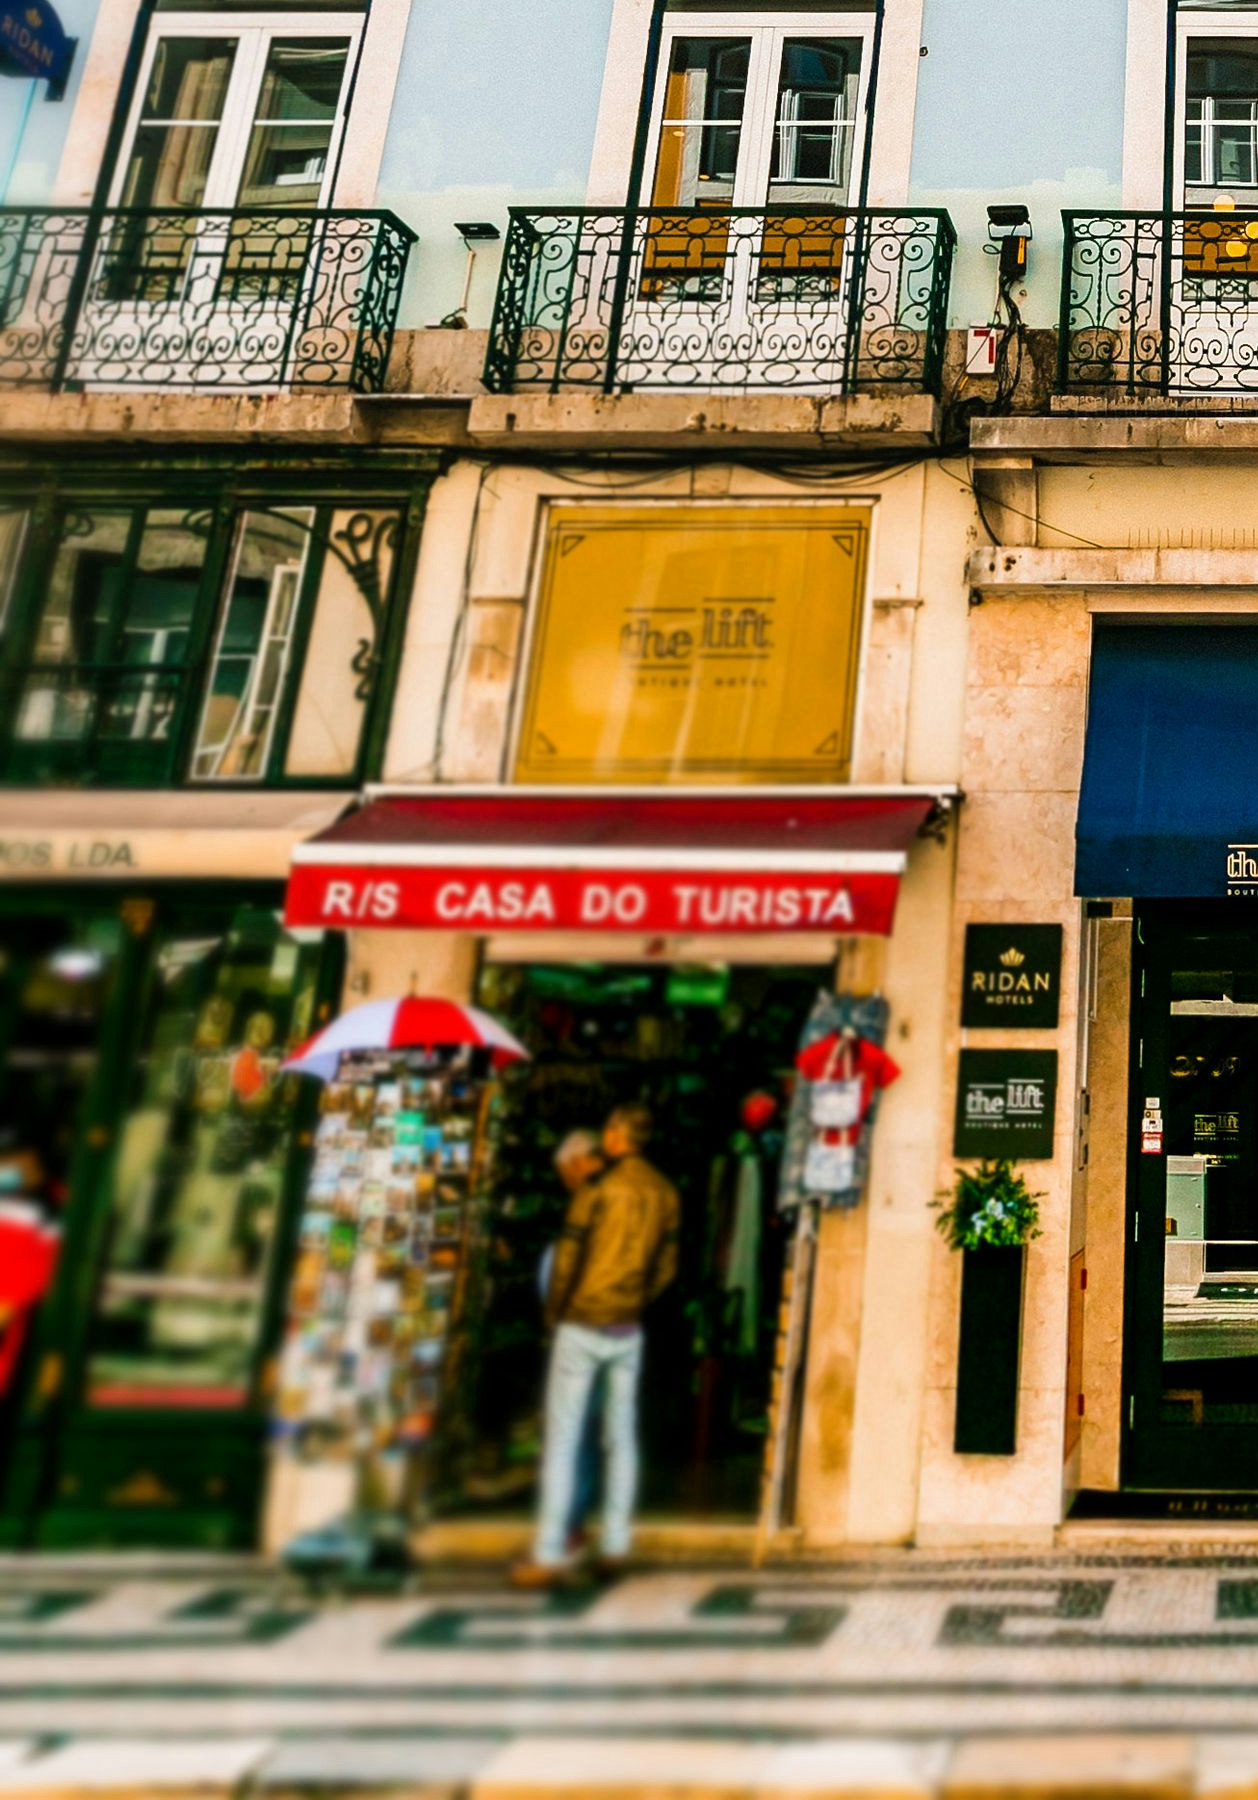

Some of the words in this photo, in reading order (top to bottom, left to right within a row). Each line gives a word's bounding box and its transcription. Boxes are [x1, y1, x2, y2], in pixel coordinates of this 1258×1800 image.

[1, 14, 54, 67] RIDAN
[620, 618, 694, 659] the
[321, 882, 399, 919] R/S
[434, 882, 557, 920] CASA
[580, 884, 646, 922] DO
[672, 885, 855, 924] TURISTA
[972, 972, 1049, 991] RIDAN
[986, 995, 1033, 1004] HOTELS
[966, 1090, 1004, 1114] the
